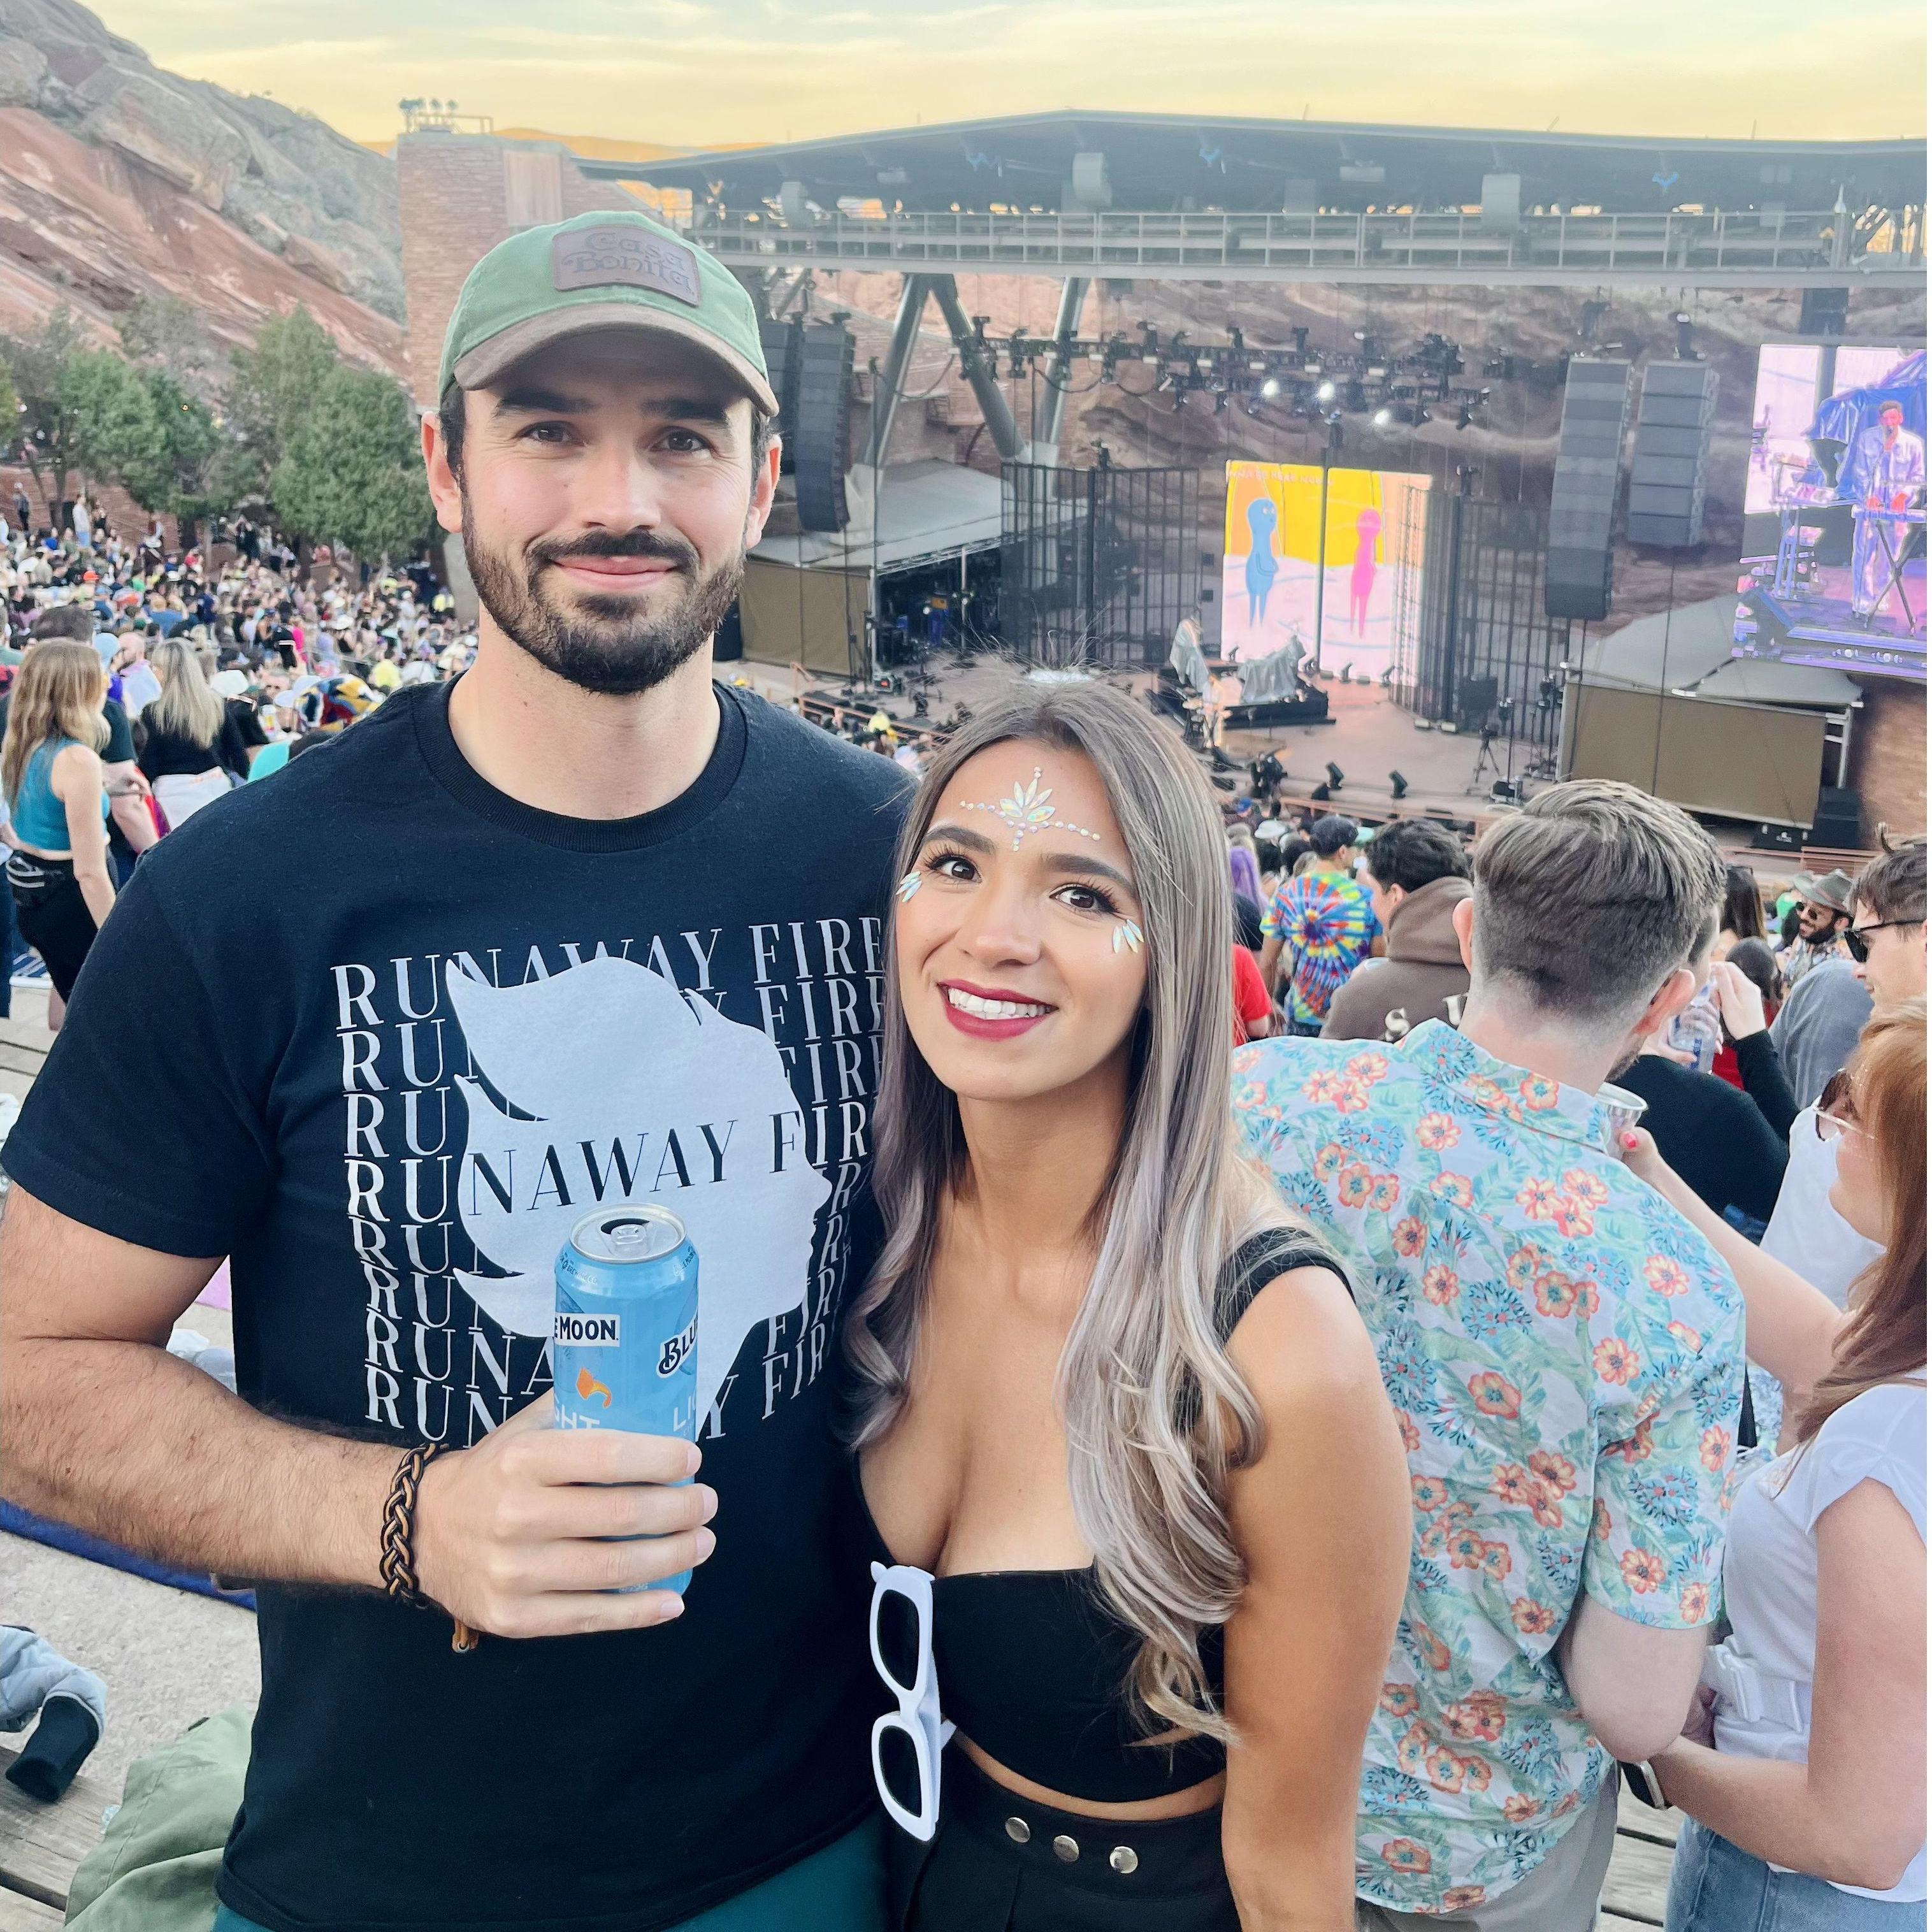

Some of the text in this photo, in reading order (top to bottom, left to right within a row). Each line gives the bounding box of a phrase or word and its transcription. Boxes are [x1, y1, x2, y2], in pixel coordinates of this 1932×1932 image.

[561, 250, 691, 290] Bonita
[584, 232, 684, 271] Casa
[748, 916, 886, 984] FIRE
[344, 1119, 739, 1223] RUNAWAY
[768, 1101, 868, 1173] FIR
[364, 1308, 554, 1395] RUNA
[761, 1322, 826, 1420] FIR
